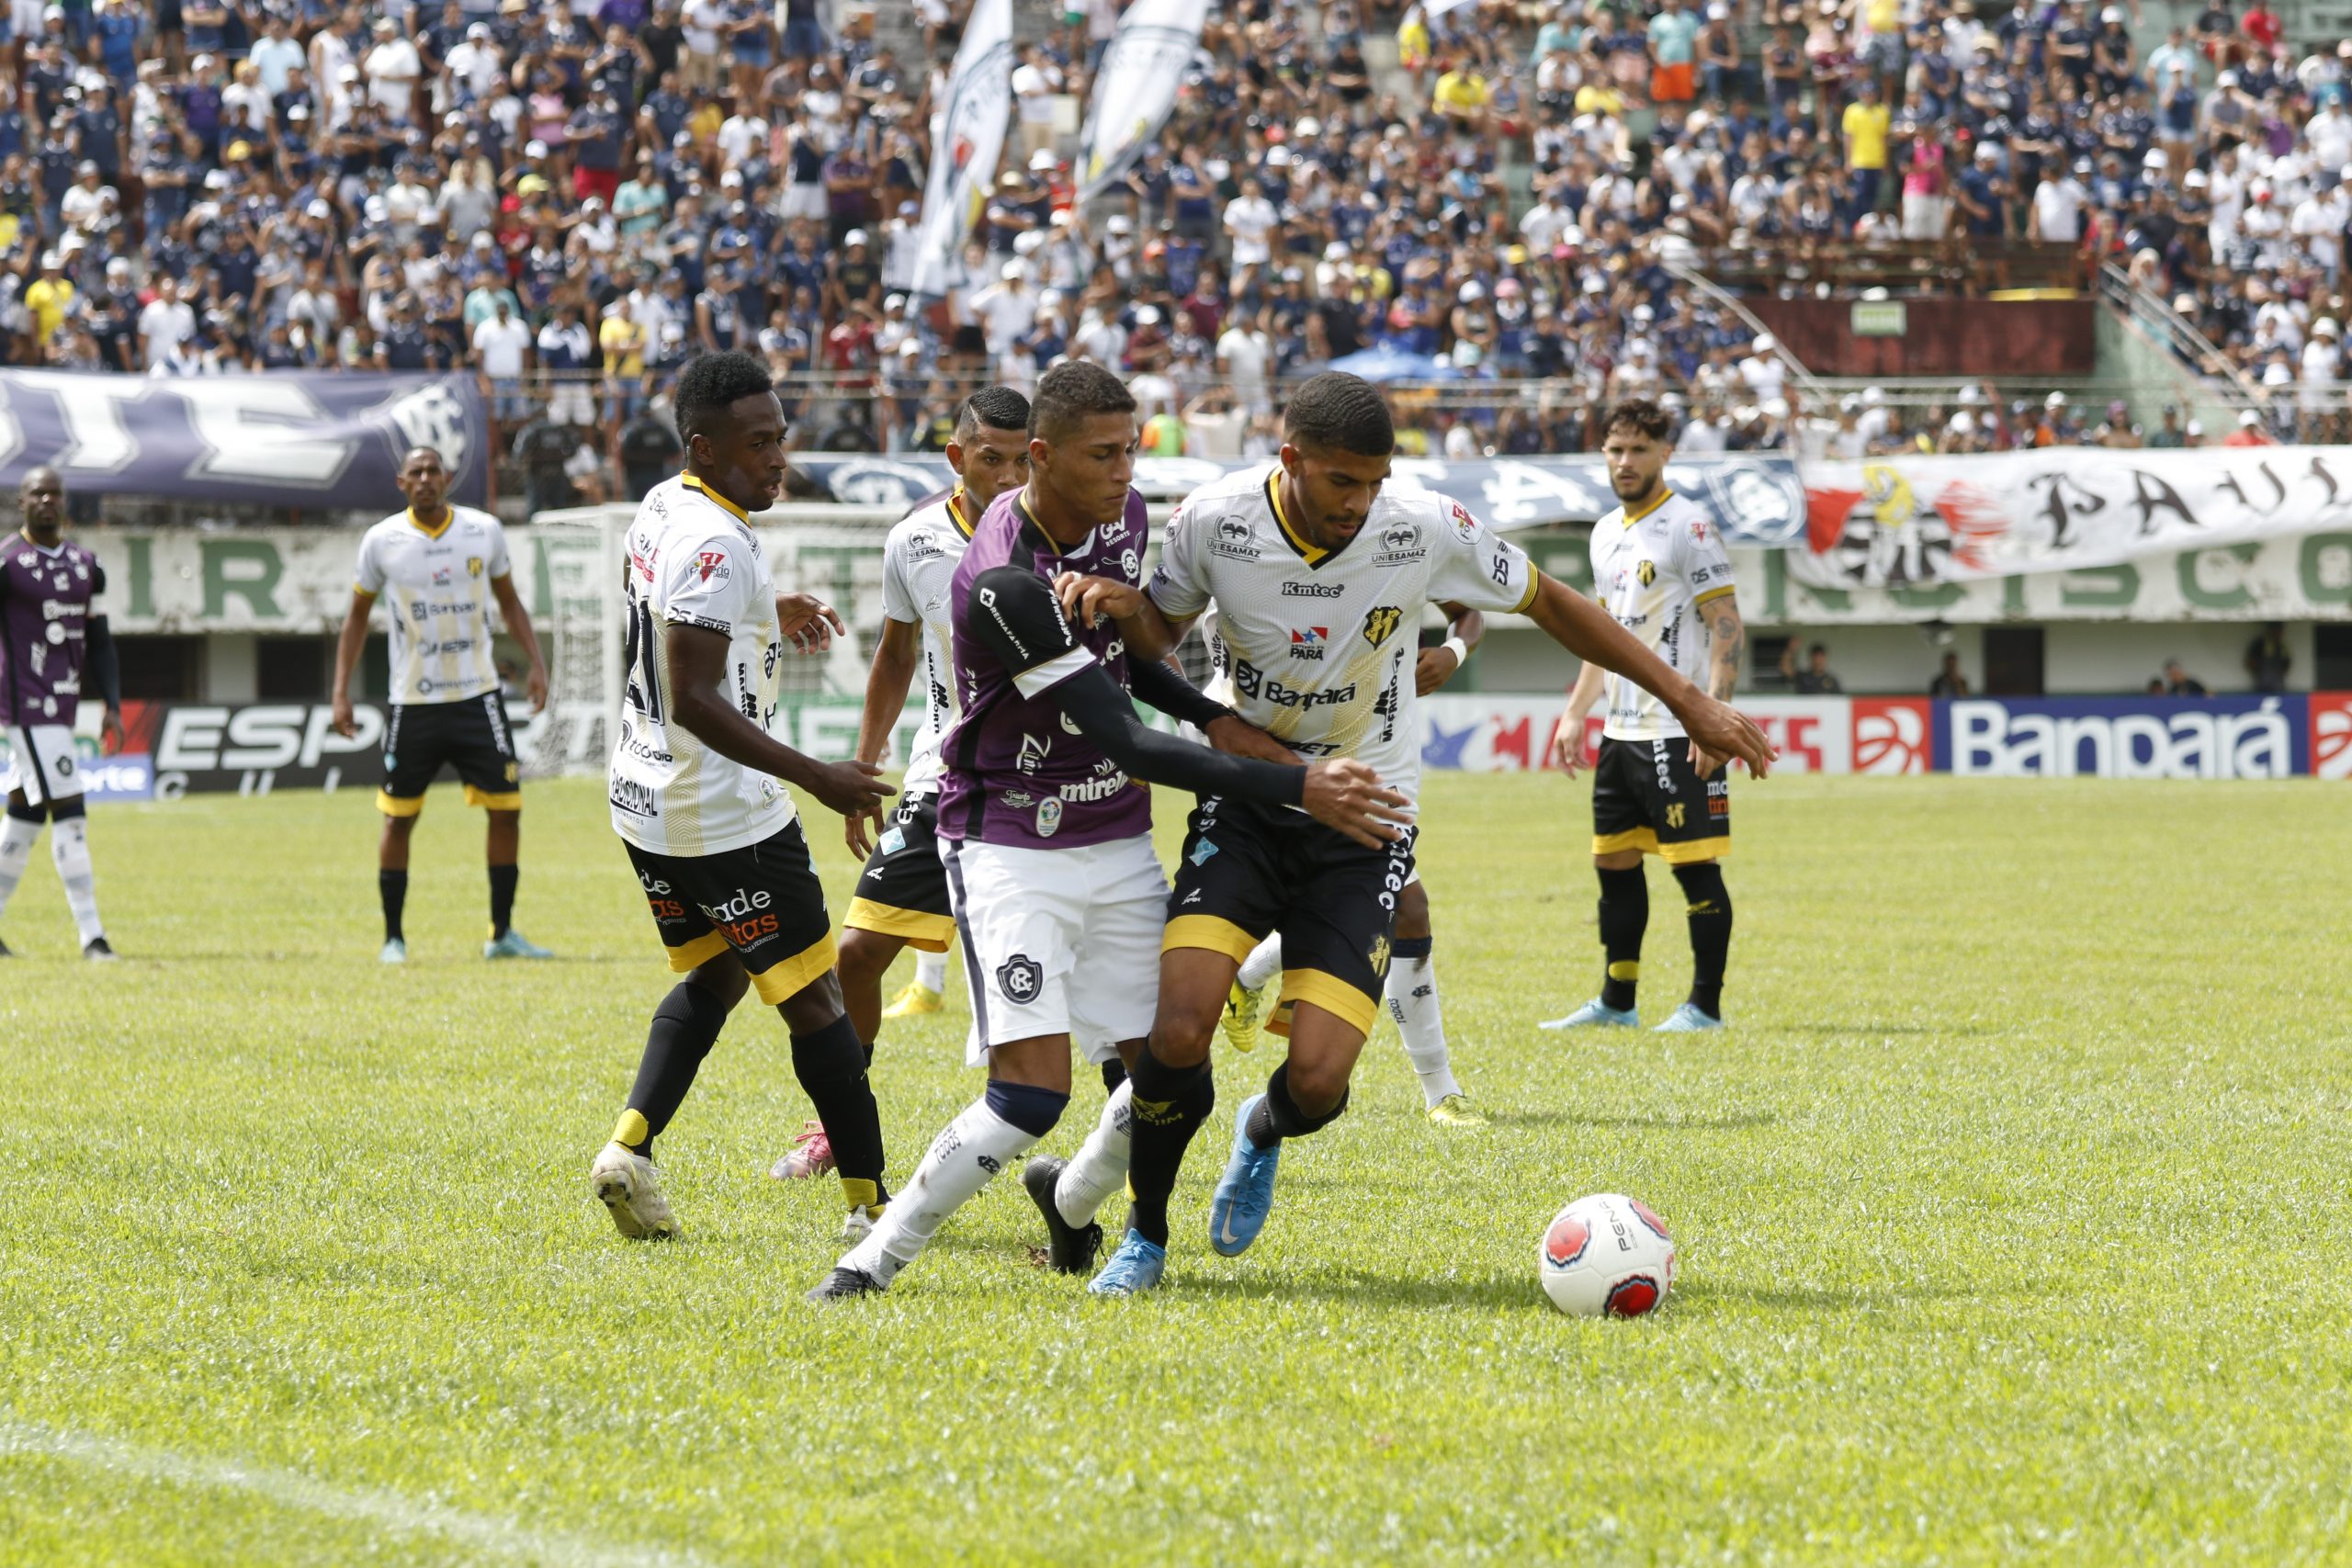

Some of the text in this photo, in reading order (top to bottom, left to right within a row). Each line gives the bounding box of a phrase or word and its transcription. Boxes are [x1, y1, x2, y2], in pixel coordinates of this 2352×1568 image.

[1105, 530, 1131, 548] RESORTS
[1206, 538, 1261, 559] UNIESAMAZ
[1371, 548, 1427, 563] UNIESAMAZ
[1282, 582, 1340, 598] Kmtec
[989, 605, 1031, 660] REINAFARMA
[1950, 695, 2291, 780] Banpará
[934, 1130, 962, 1165] TODOS
